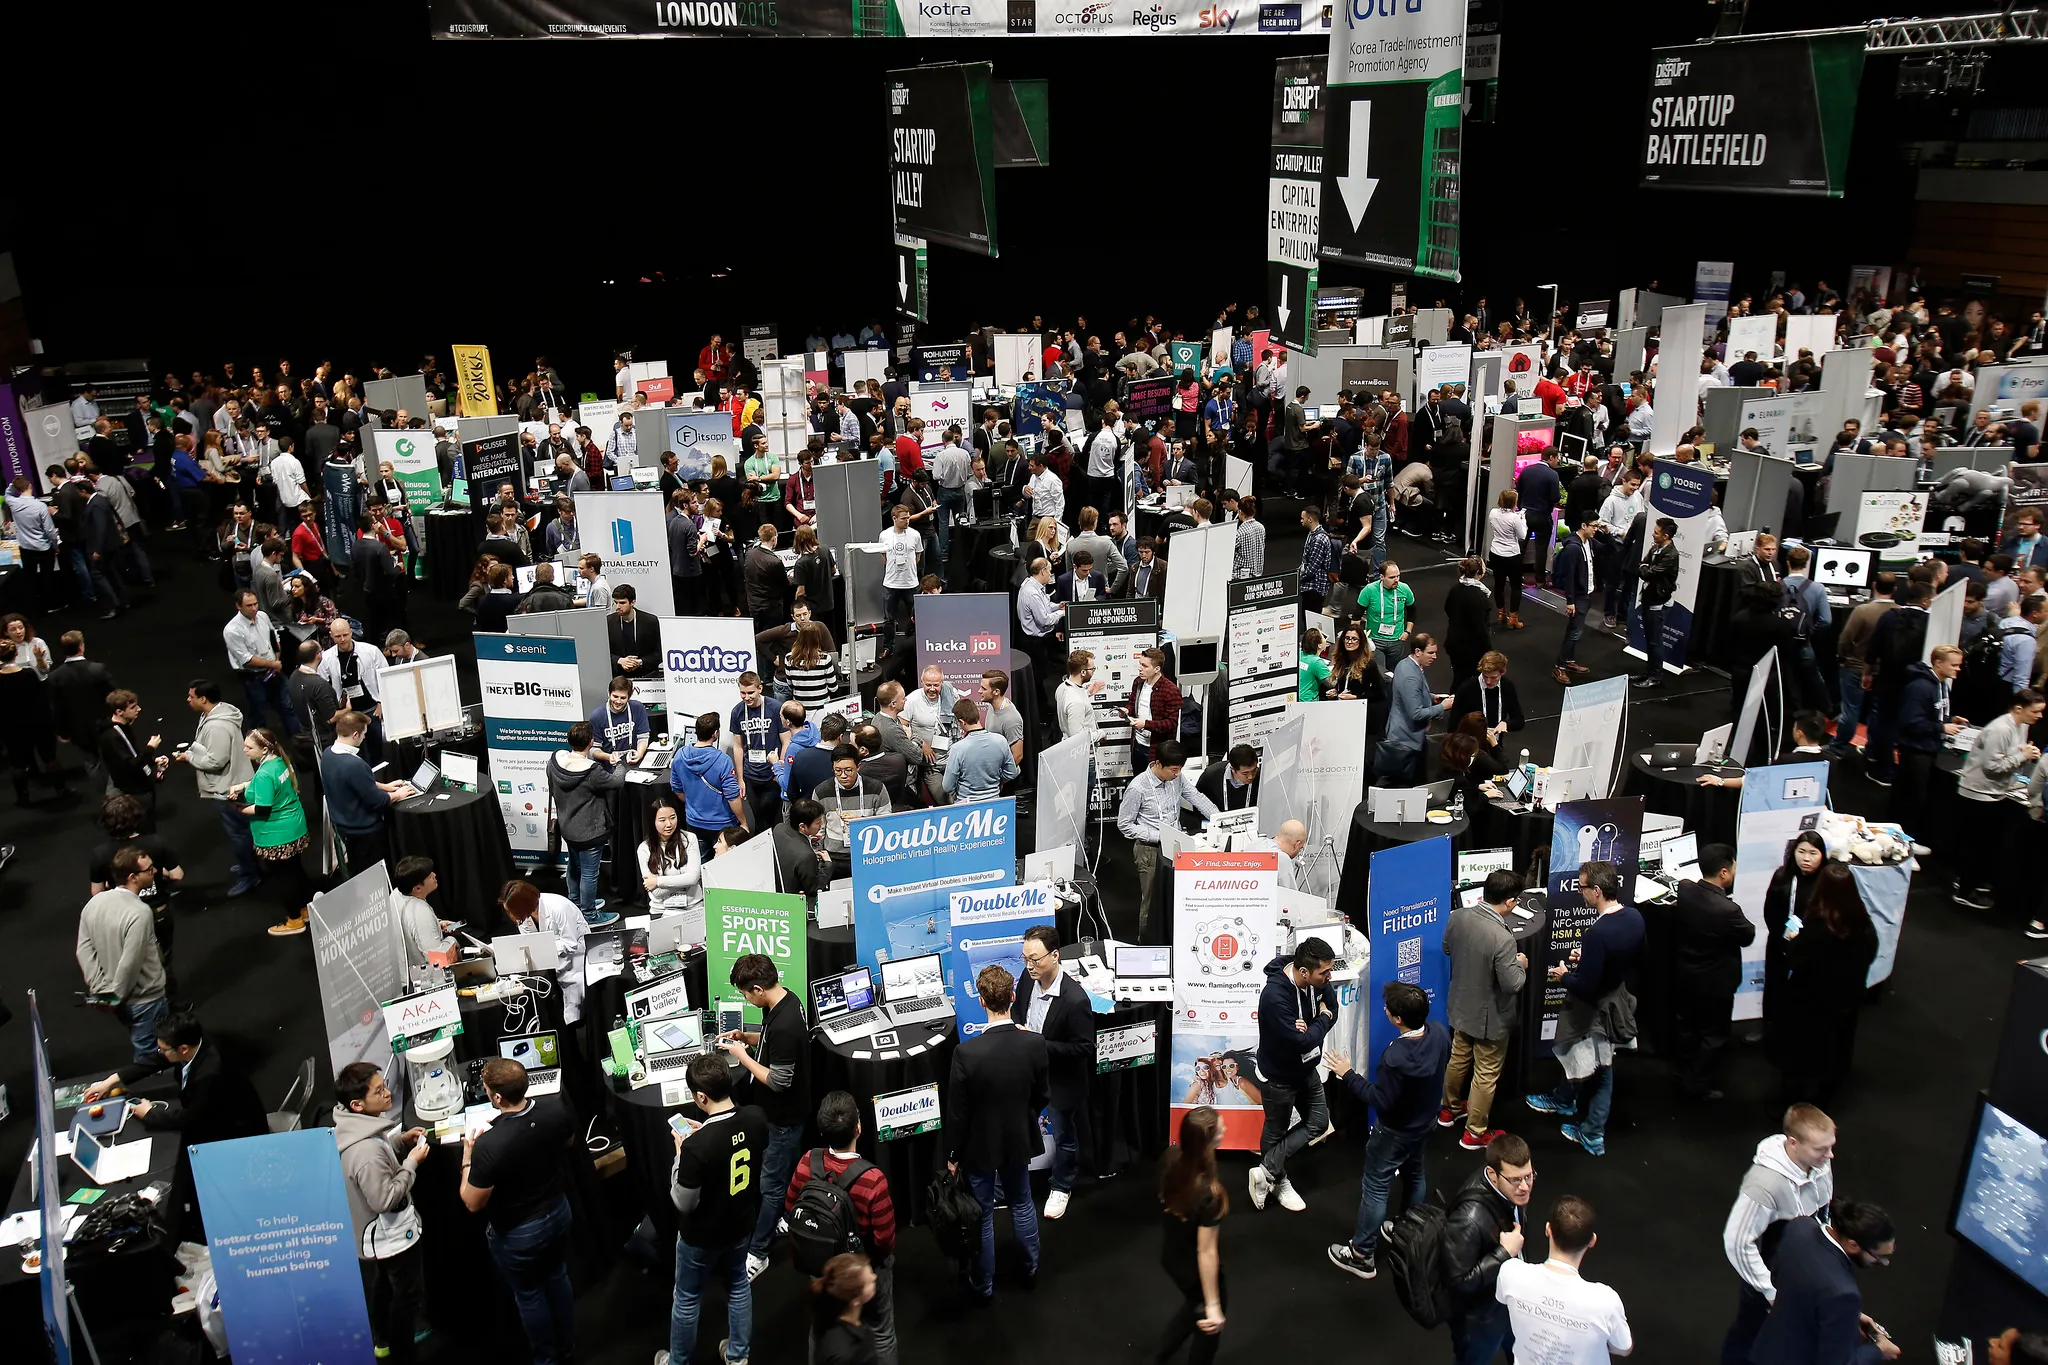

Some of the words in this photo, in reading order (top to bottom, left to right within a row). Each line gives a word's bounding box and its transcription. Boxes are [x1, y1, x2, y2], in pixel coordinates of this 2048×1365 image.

[920, 2, 971, 18] kotra
[1264, 9, 1272, 17] WE
[1274, 9, 1284, 17] ARE
[1011, 19, 1033, 27] STAR
[1056, 13, 1113, 24] OCTOPUS
[1133, 11, 1177, 32] Regus
[1199, 5, 1239, 33] sky
[1262, 19, 1277, 27] TECH
[1279, 19, 1298, 27] NORTH
[450, 24, 488, 32] #TCDISRUPT
[548, 24, 627, 33] TECHCRUNCH.COM/EVENTS
[1350, 42, 1376, 55] Korea
[1379, 32, 1462, 51] Trade-Investment
[1349, 57, 1395, 73] Promotion
[1398, 57, 1429, 73] Agency
[1656, 62, 1691, 78] DISRUPT
[1283, 86, 1320, 110] DISRUPT
[1650, 95, 1735, 127] STARTUP
[894, 128, 935, 165] STARTUP
[1646, 134, 1767, 165] BATTLEFIELD
[1276, 154, 1303, 172] STARTUP
[1303, 155, 1323, 174] ALLEY
[896, 172, 923, 208] ALLEY
[1282, 184, 1316, 208] CAPITAL
[1272, 210, 1319, 236] ENTERPRIS
[1280, 237, 1316, 263] PAVILION
[902, 324, 915, 333] VOTE
[1131, 391, 1146, 400] IMAGE
[1147, 388, 1170, 398] RESIZING
[1142, 399, 1156, 407] CLOUD
[925, 417, 966, 429] apwize
[483, 440, 507, 450] GLISSER
[490, 452, 507, 460] MAKE
[472, 457, 516, 472] PRESENTATIONS
[472, 463, 519, 480] INTERACTIVE
[1673, 477, 1702, 490] YOOBIC
[1246, 584, 1263, 593] THANK
[1256, 588, 1283, 599] SPONSORS
[1090, 609, 1112, 617] THANK
[1103, 615, 1137, 624] SPONSORS
[1264, 625, 1274, 633] esri
[516, 645, 546, 654] seenit
[925, 640, 967, 652] hacka
[972, 639, 997, 653] job
[668, 646, 751, 672] natter
[674, 675, 697, 684] short
[700, 676, 716, 684] and
[489, 686, 513, 695] NEXT
[514, 682, 541, 696] BIG
[543, 688, 571, 698] THING
[1090, 786, 1126, 802] RUPT
[863, 852, 907, 865] Holographic
[909, 848, 931, 858] Virtual
[933, 843, 958, 853] Reality
[960, 837, 1005, 850] Experiences!
[1469, 861, 1510, 872] Keypair
[887, 887, 902, 895] Make
[903, 884, 922, 892] Instant
[922, 881, 938, 889] Virtual
[940, 877, 961, 886] Doubles
[968, 873, 994, 882] HoloPortal
[1194, 880, 1259, 890] FLAMINGO
[873, 889, 880, 898] 1
[722, 906, 759, 914] ESSENTIAL
[1384, 908, 1399, 917] Need
[1400, 897, 1438, 915] Translations?
[1554, 908, 1570, 917] The
[722, 915, 790, 934] SPORTS
[1383, 914, 1422, 935] Flitto
[1424, 907, 1437, 923] it!
[1552, 930, 1572, 939] HSM
[1575, 929, 1581, 938] &
[723, 932, 791, 957] FANS
[651, 986, 681, 1003] breeze
[402, 1000, 441, 1020] AKA
[653, 996, 678, 1011] valley
[407, 1021, 420, 1029] THE
[1101, 1039, 1138, 1051] FLAMINGO
[732, 1131, 746, 1147] BO
[729, 1148, 751, 1196] 6
[256, 1218, 271, 1228] To
[273, 1214, 299, 1226] help
[214, 1234, 251, 1247] better
[254, 1221, 344, 1240] communication
[229, 1242, 282, 1256] between
[286, 1237, 299, 1248] all
[302, 1235, 338, 1244] things
[259, 1249, 310, 1264] including
[246, 1265, 287, 1278] human
[290, 1258, 330, 1271] beings
[1542, 1296, 1565, 1310] 2015
[1517, 1300, 1533, 1314] Sky
[1535, 1306, 1589, 1330] Developers
